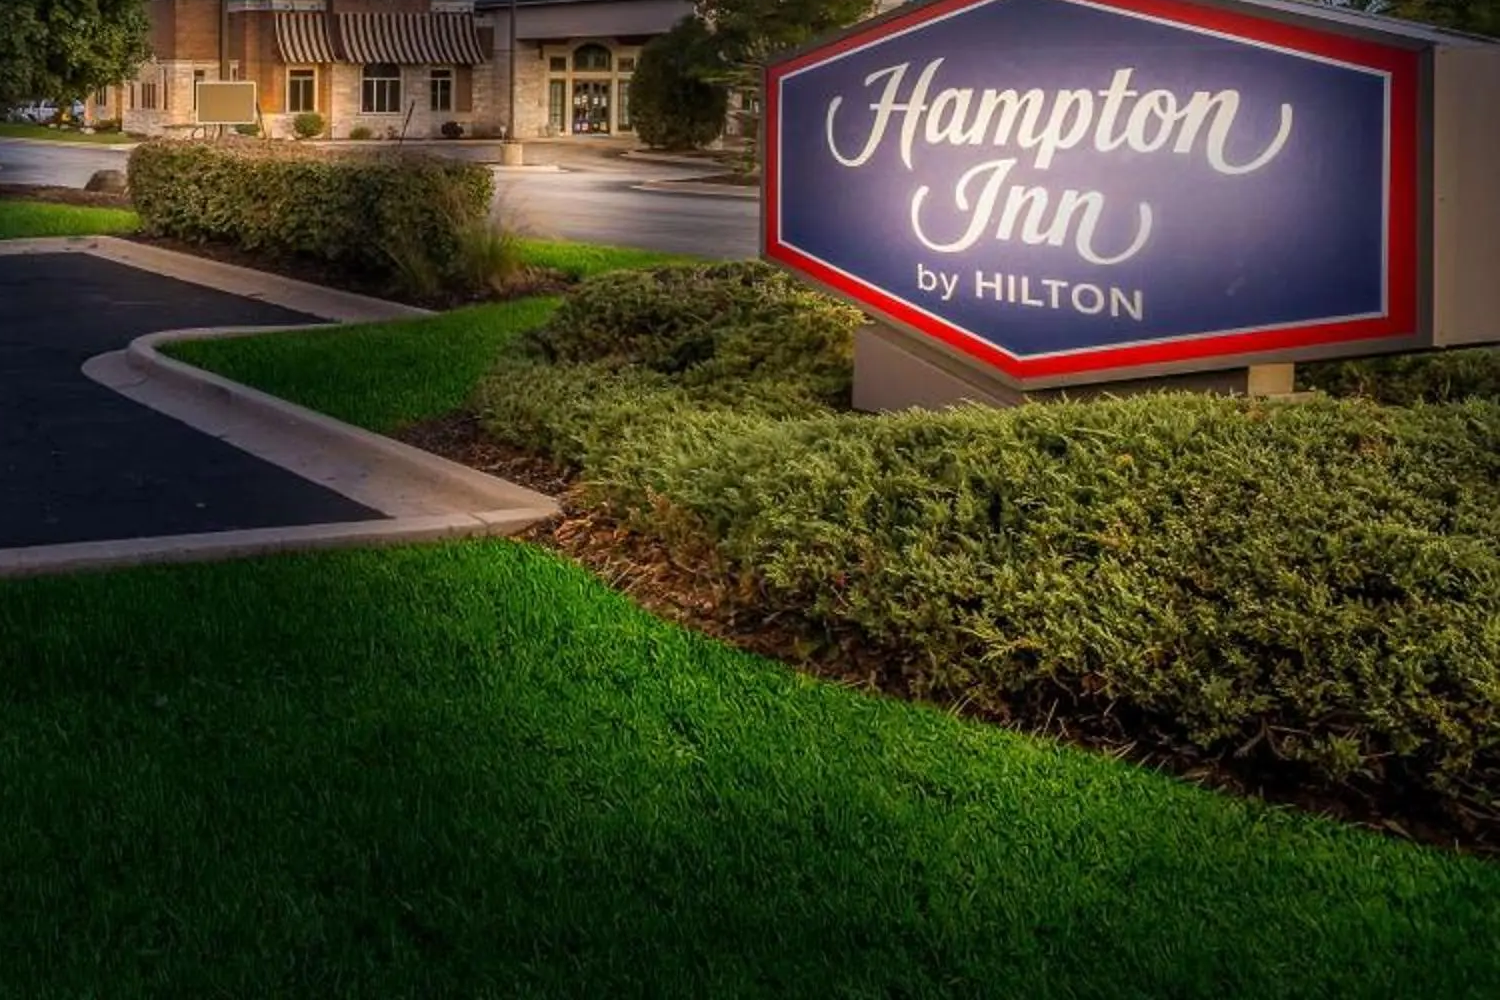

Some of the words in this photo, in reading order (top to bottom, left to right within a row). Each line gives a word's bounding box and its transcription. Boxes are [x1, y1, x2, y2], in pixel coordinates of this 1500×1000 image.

[826, 57, 1293, 175] Hampton
[910, 158, 1153, 265] Inn
[917, 263, 957, 301] by
[975, 270, 1144, 322] HILTON
